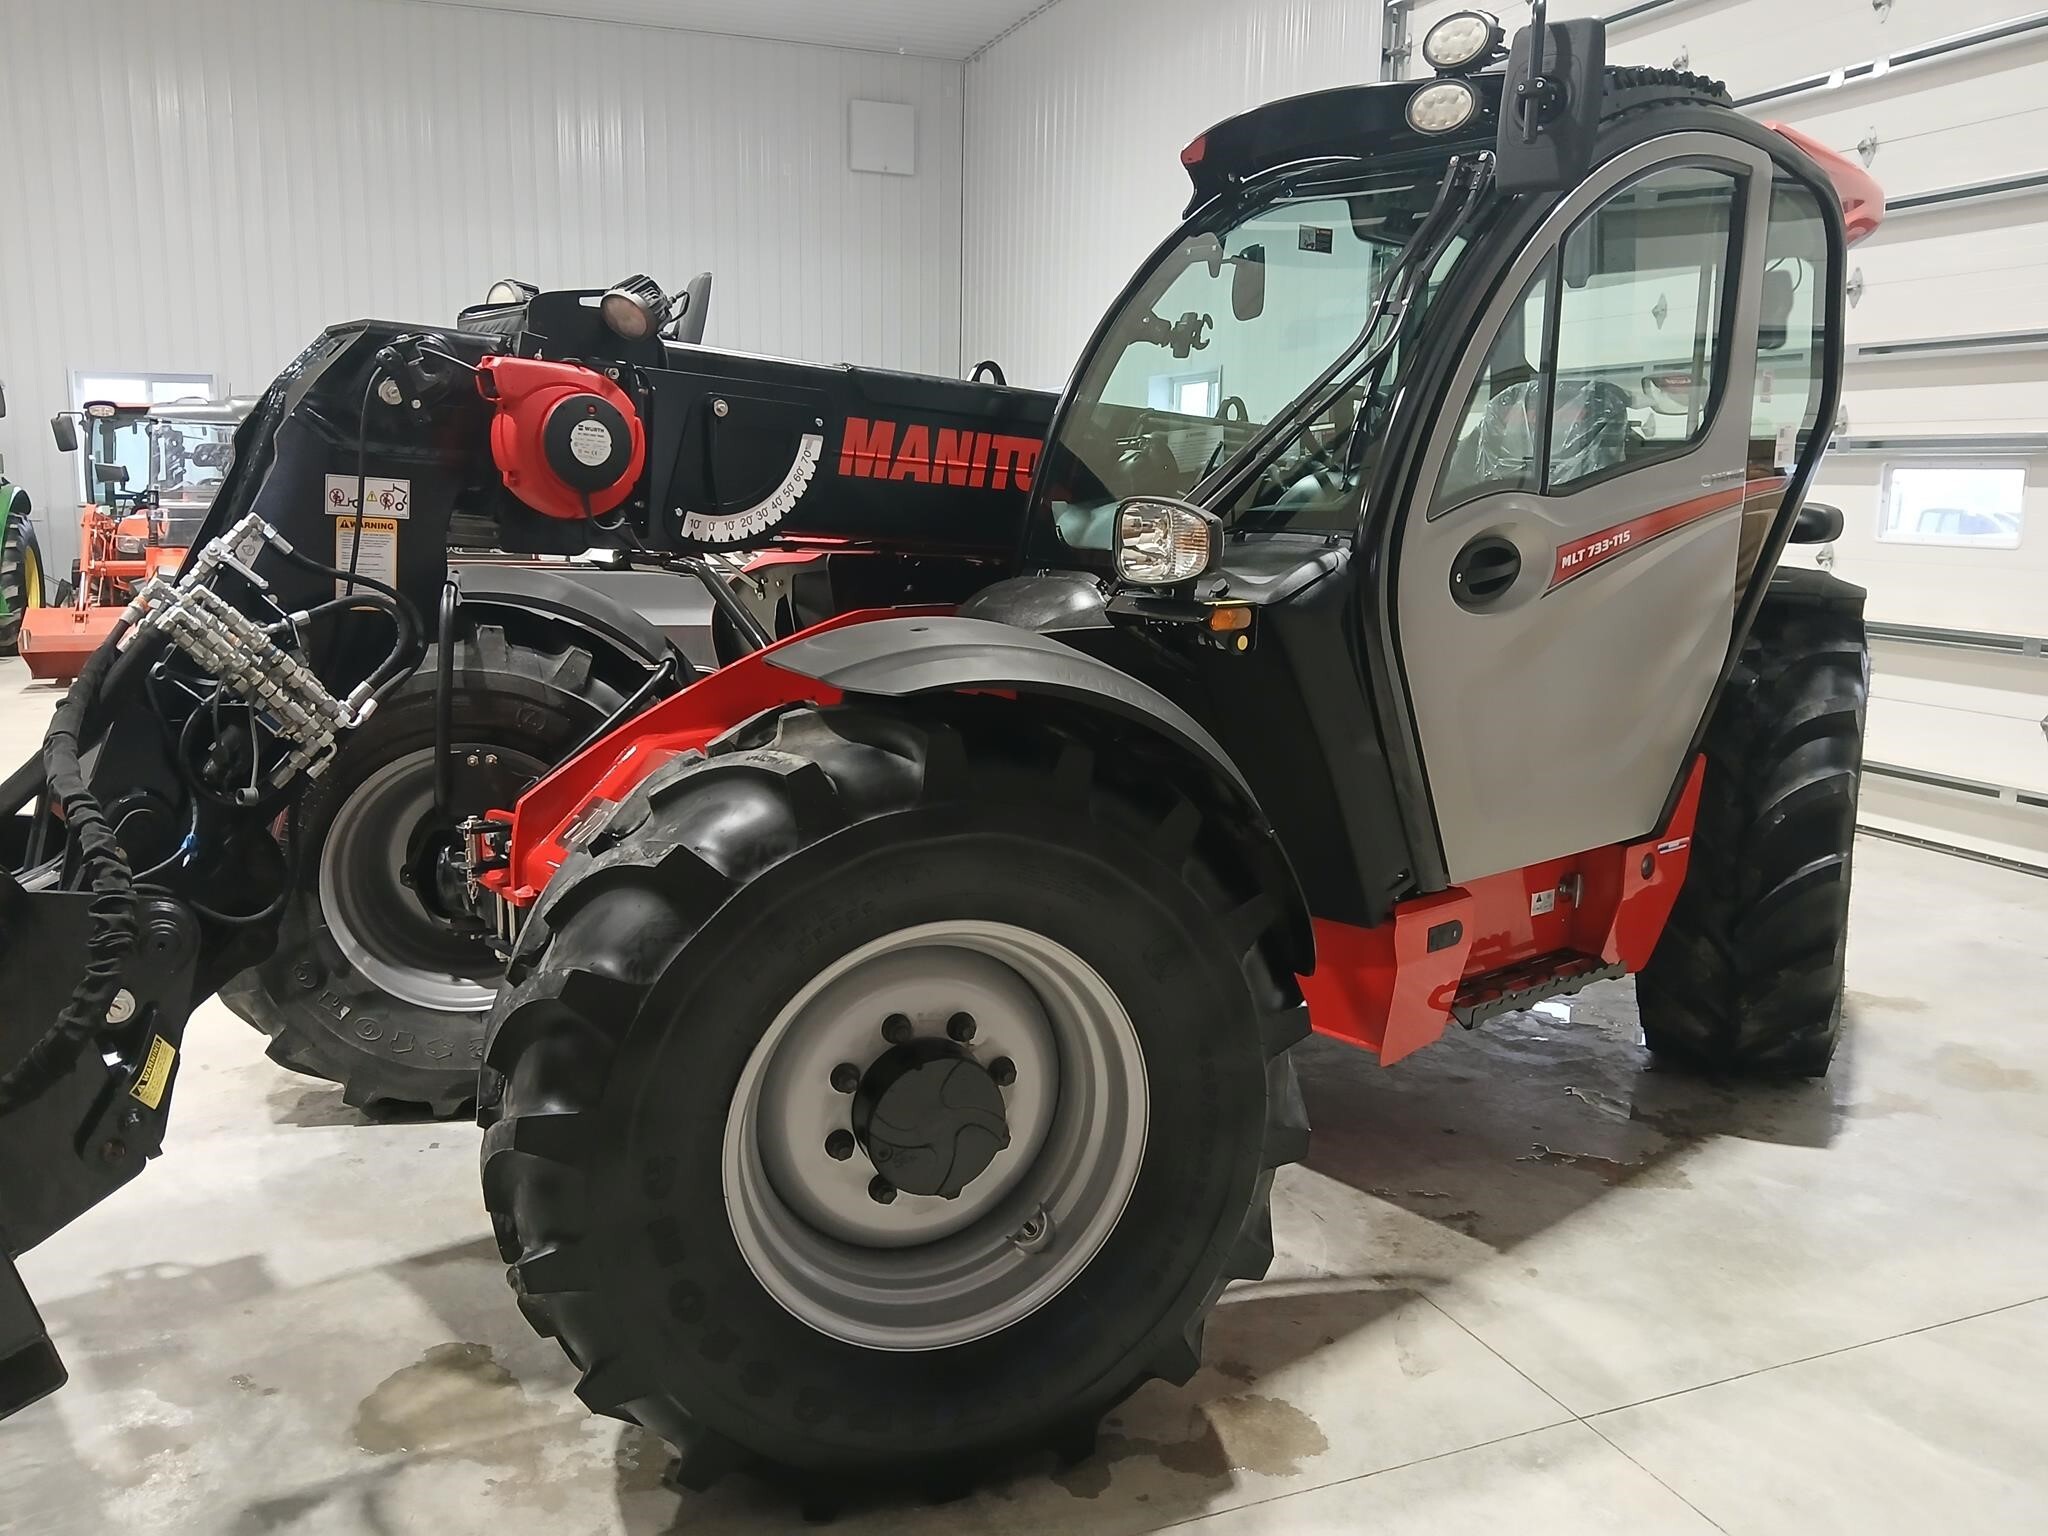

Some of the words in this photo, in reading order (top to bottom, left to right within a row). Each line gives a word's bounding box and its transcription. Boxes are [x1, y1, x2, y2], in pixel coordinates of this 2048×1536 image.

[1561, 549, 1587, 569] MLT
[1587, 530, 1631, 558] 733-115
[142, 1041, 161, 1082] WARNING
